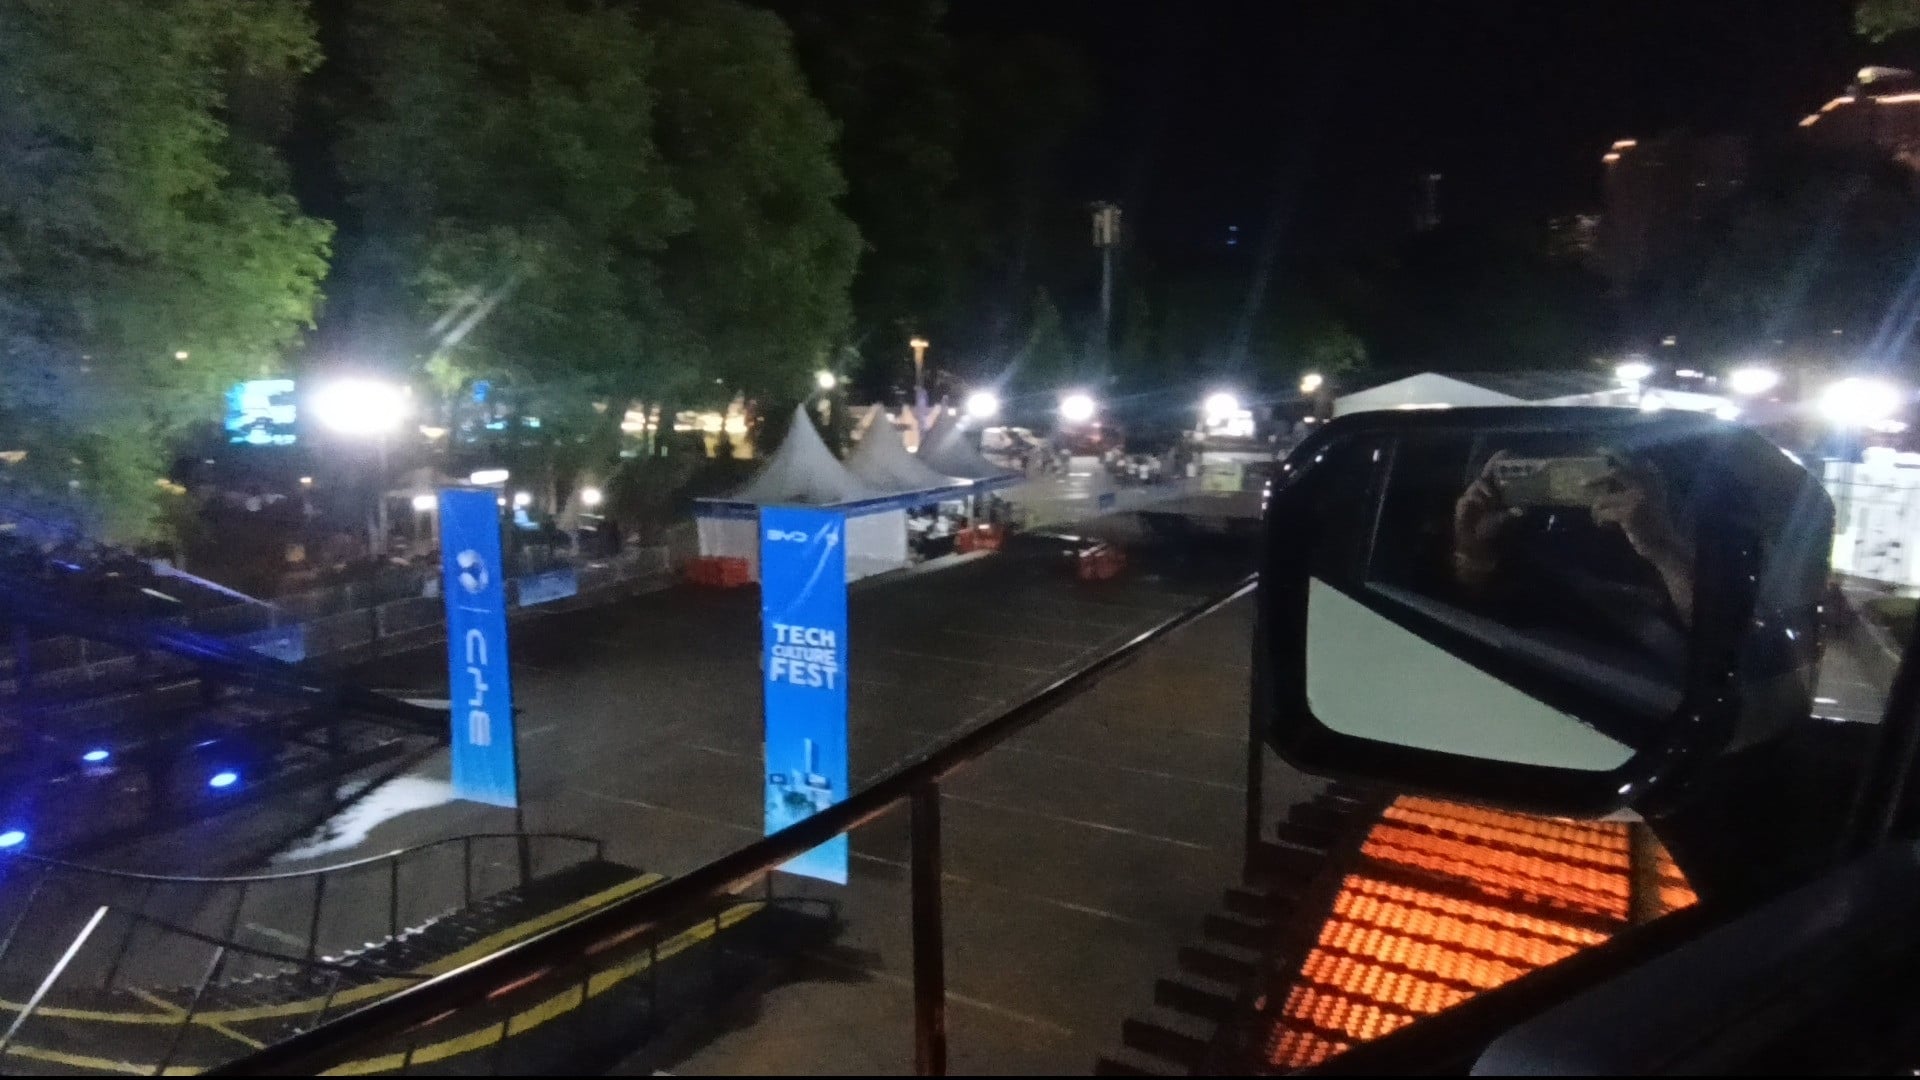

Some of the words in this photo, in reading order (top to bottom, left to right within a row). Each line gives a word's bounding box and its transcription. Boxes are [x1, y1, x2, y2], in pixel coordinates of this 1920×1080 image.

[767, 529, 808, 542] BYD
[773, 623, 836, 648] TECH
[771, 645, 837, 665] CULTURE
[769, 658, 838, 689] FEST
[465, 629, 491, 746] BYD
